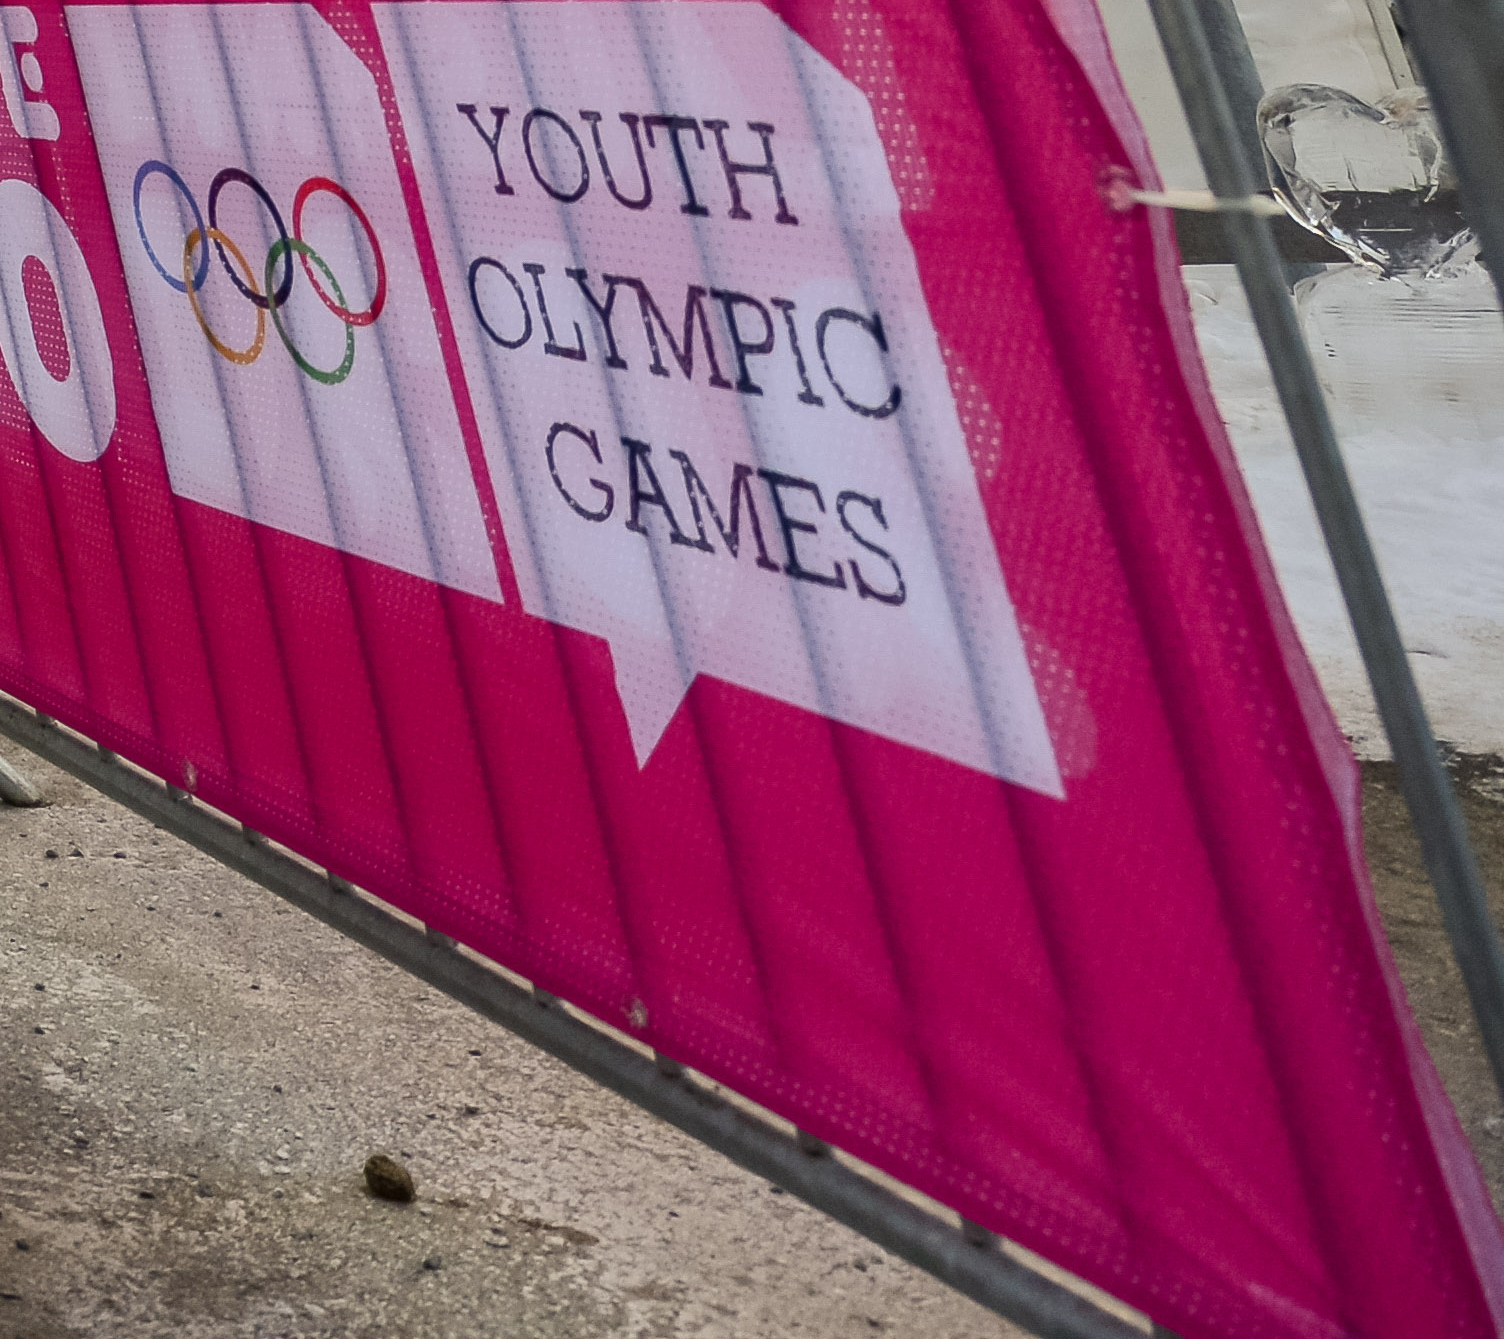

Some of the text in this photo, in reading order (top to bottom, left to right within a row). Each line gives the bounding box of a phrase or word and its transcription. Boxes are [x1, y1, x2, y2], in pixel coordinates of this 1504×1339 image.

[456, 103, 799, 226] YOUTH
[468, 256, 902, 420] OLYMPIC
[545, 422, 907, 607] GAMES
